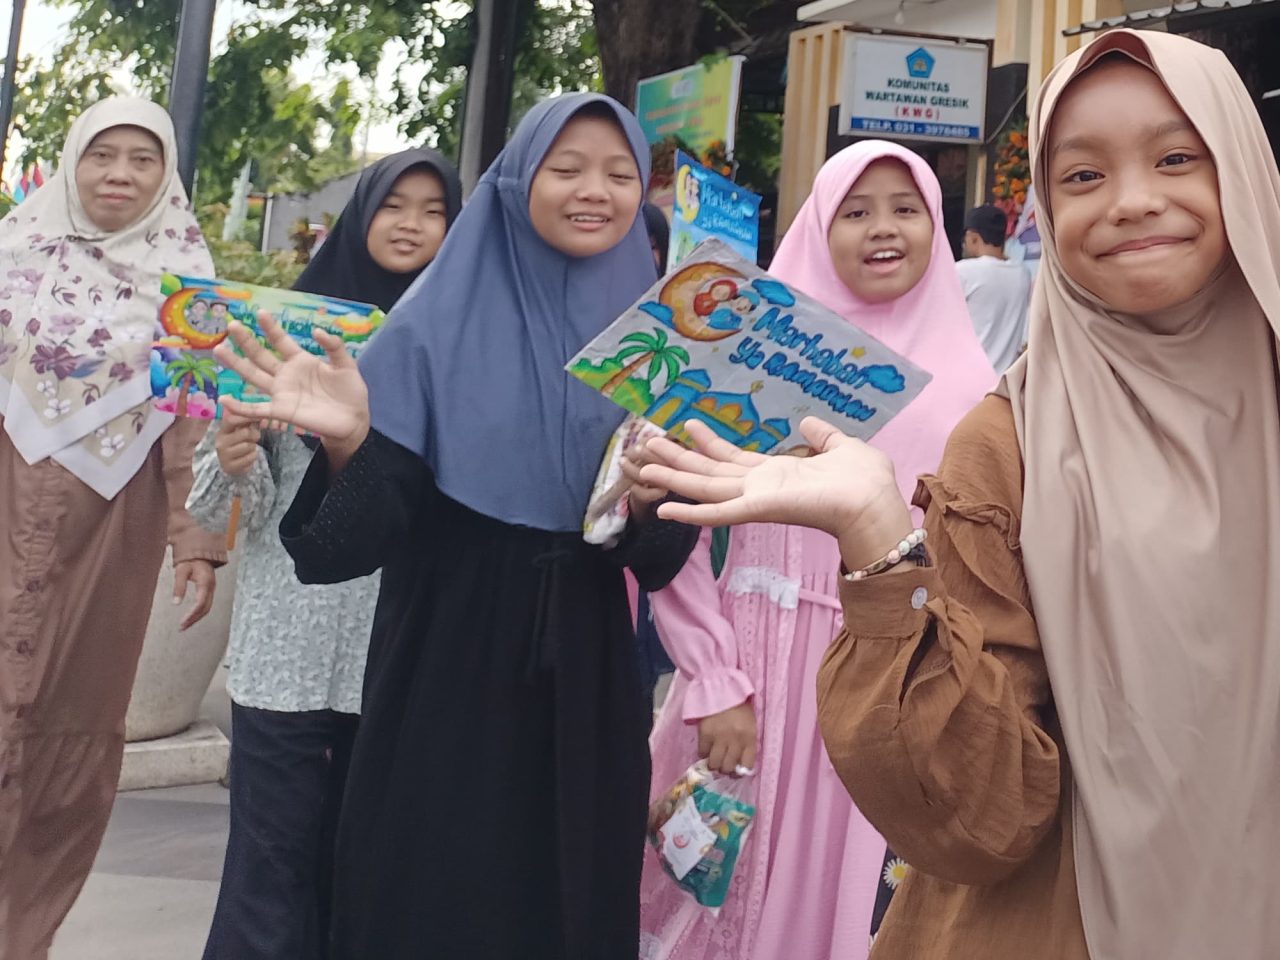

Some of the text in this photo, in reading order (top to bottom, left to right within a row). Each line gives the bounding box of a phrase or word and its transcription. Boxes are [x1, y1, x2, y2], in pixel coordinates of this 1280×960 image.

[887, 78, 950, 93] KOMUNITAS
[865, 91, 969, 109] WARTAWAN GRESIK
[752, 307, 873, 390] Marhaban
